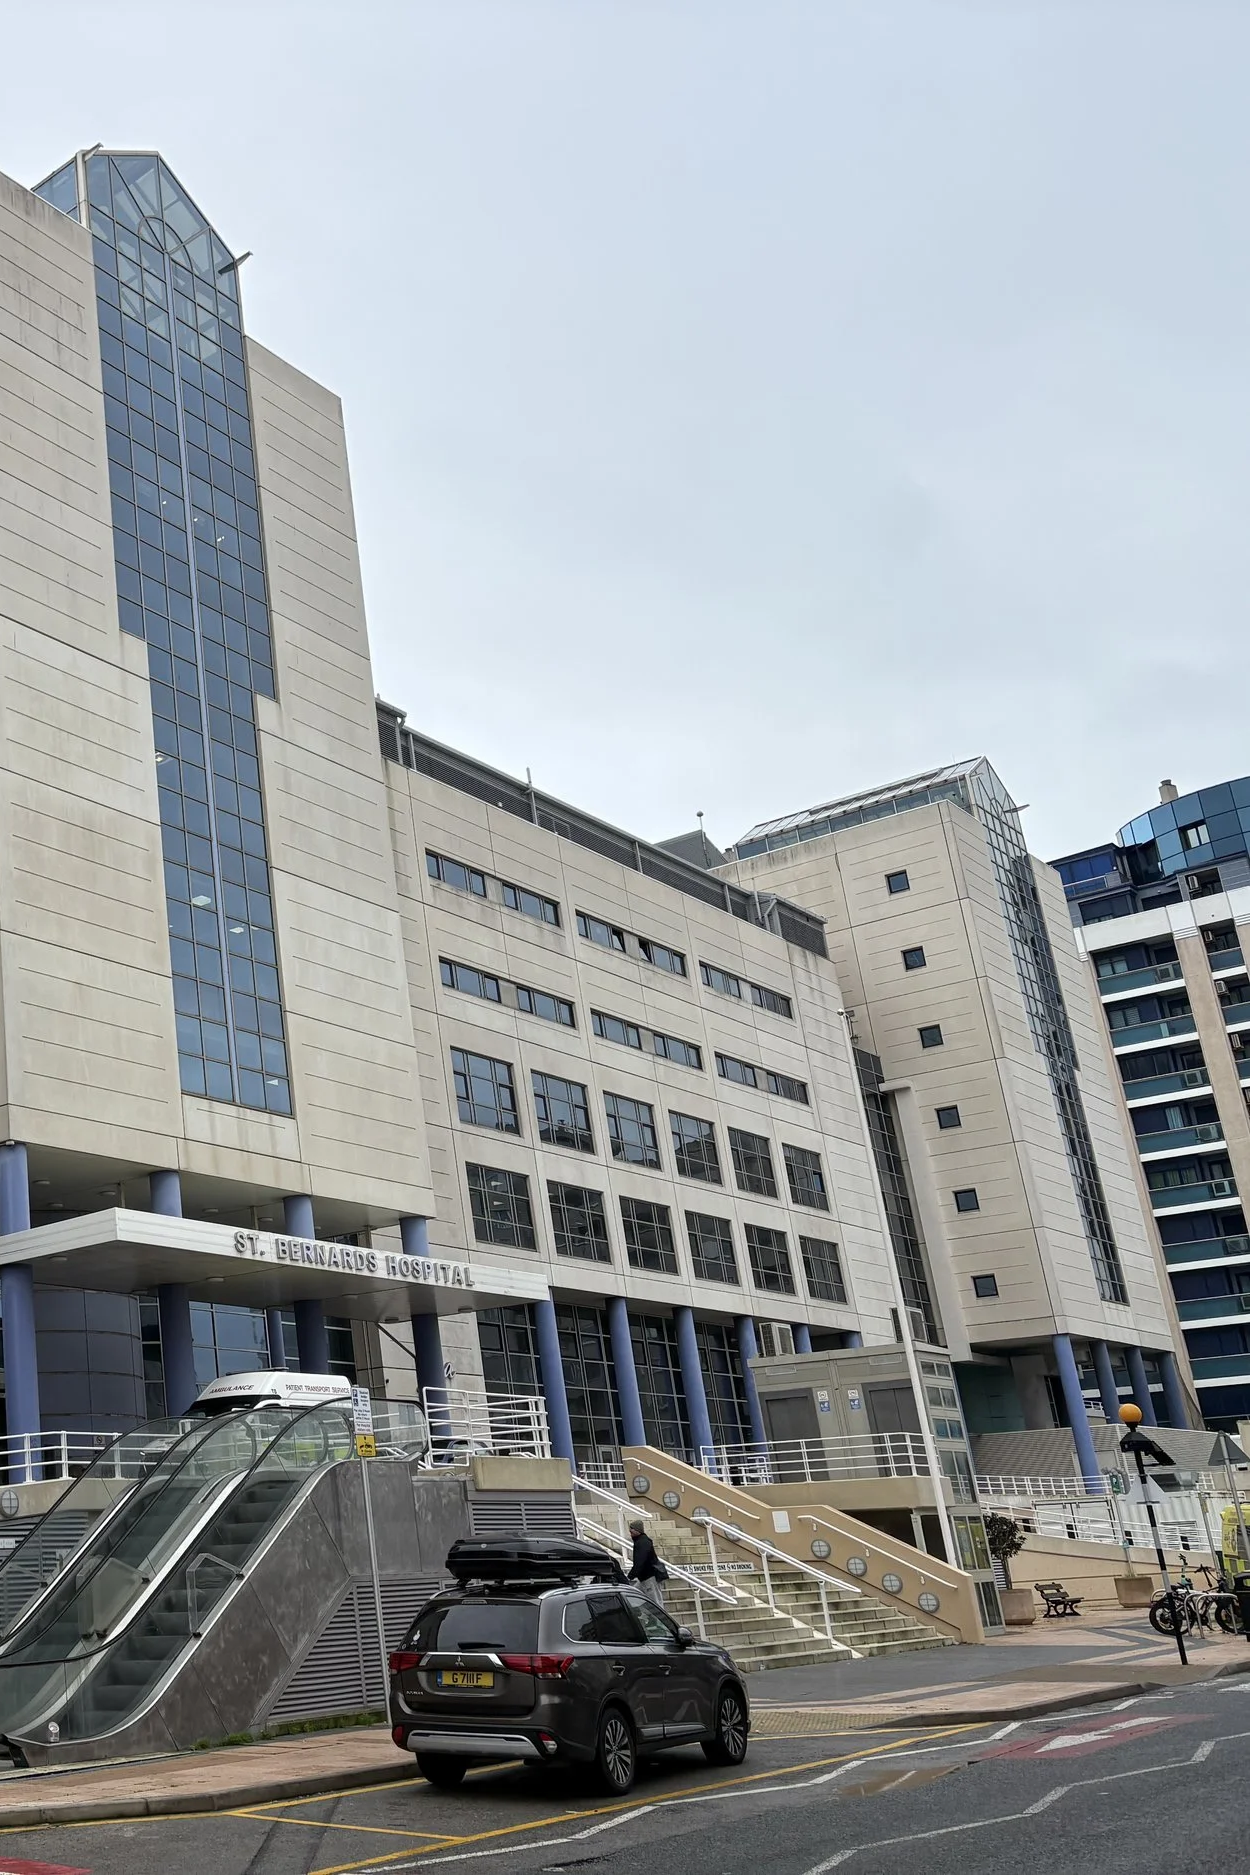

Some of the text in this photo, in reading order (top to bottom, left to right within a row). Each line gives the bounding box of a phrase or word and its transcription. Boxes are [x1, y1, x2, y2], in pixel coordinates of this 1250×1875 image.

[233, 1231, 476, 1287] ST. BERNARDS HOSPITAL
[209, 1384, 255, 1394] AMBULANCE
[304, 1385, 331, 1393] TRANSPORT
[331, 1386, 350, 1394] SERVICE
